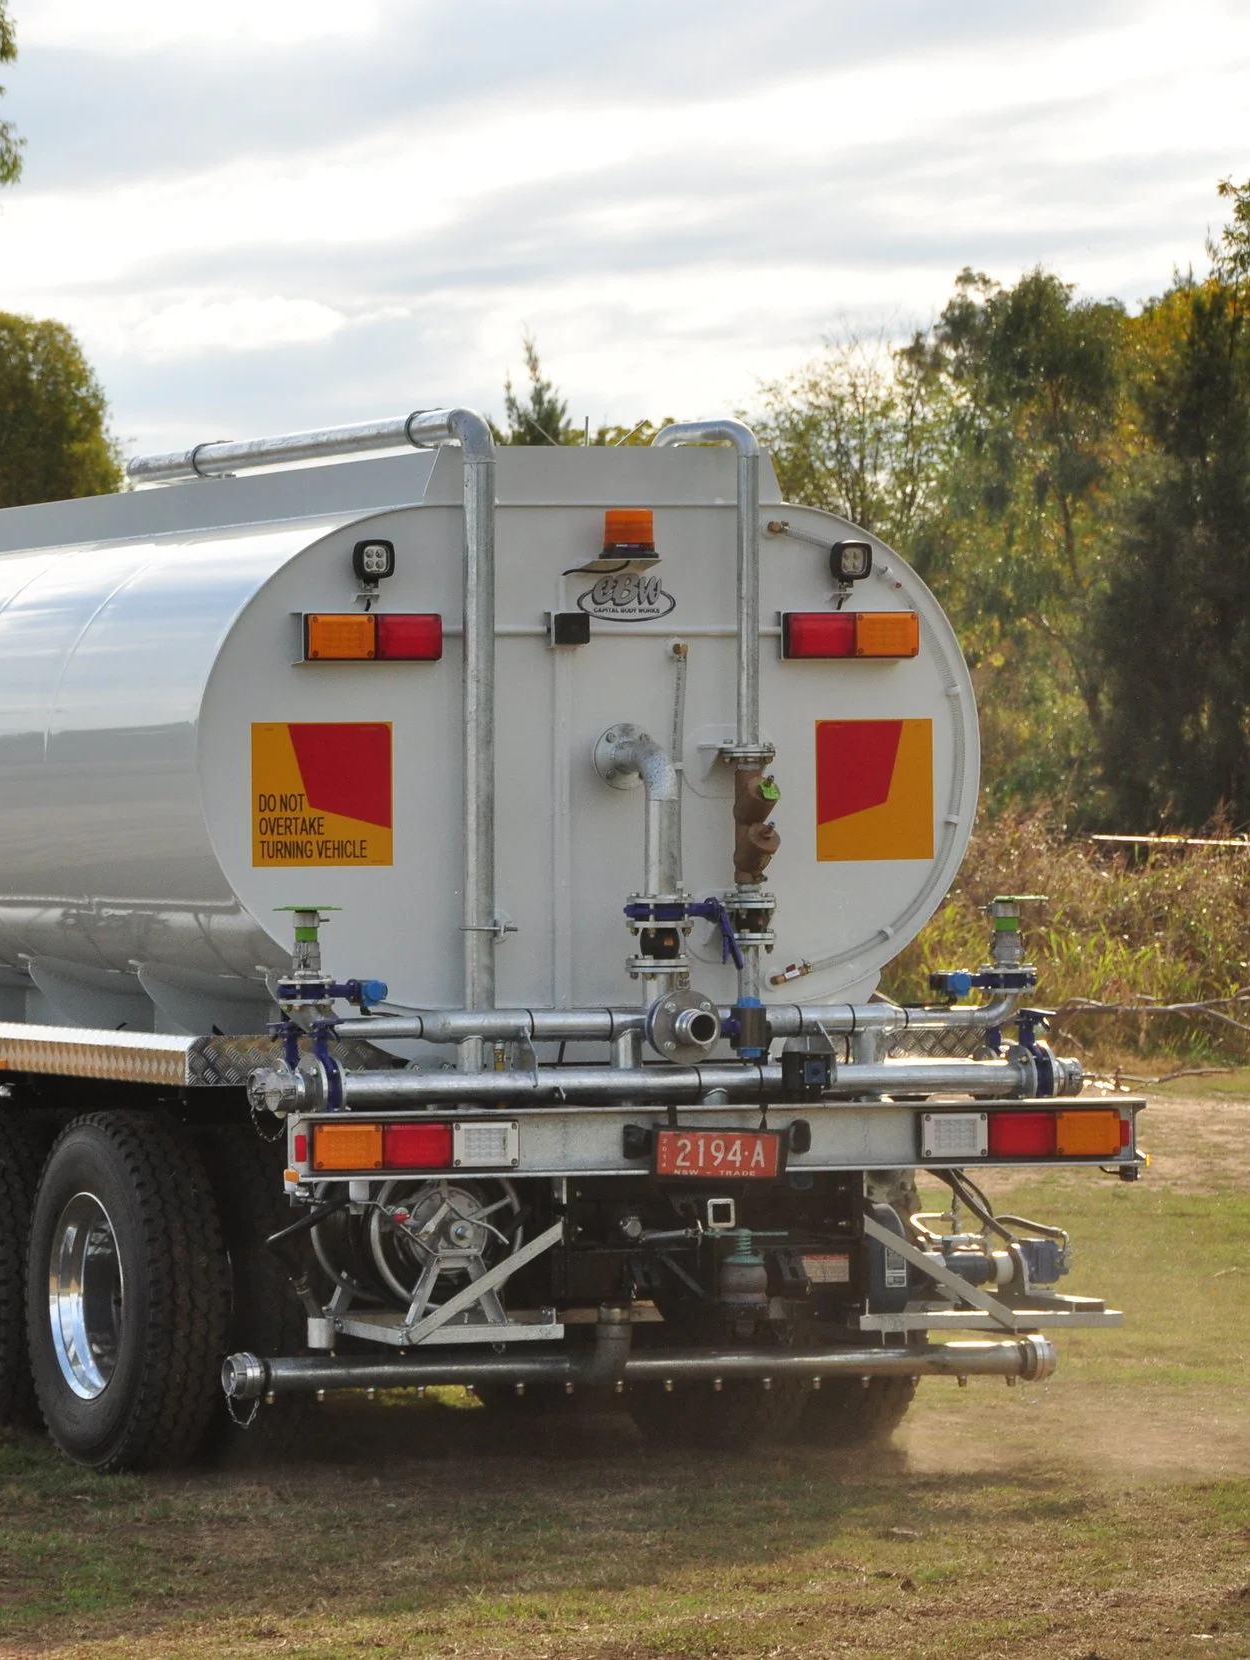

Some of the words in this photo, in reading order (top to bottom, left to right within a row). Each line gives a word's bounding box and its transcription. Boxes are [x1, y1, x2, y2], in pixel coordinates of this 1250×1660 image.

[591, 573, 662, 606] CBW
[258, 793, 276, 812] DO
[279, 793, 305, 812] NOT
[259, 817, 324, 836] OVERTAKE
[260, 840, 313, 859] TURNING
[316, 839, 367, 858] VEHICLE
[673, 1168, 700, 1176] NSW
[719, 1169, 757, 1177] TRADE
